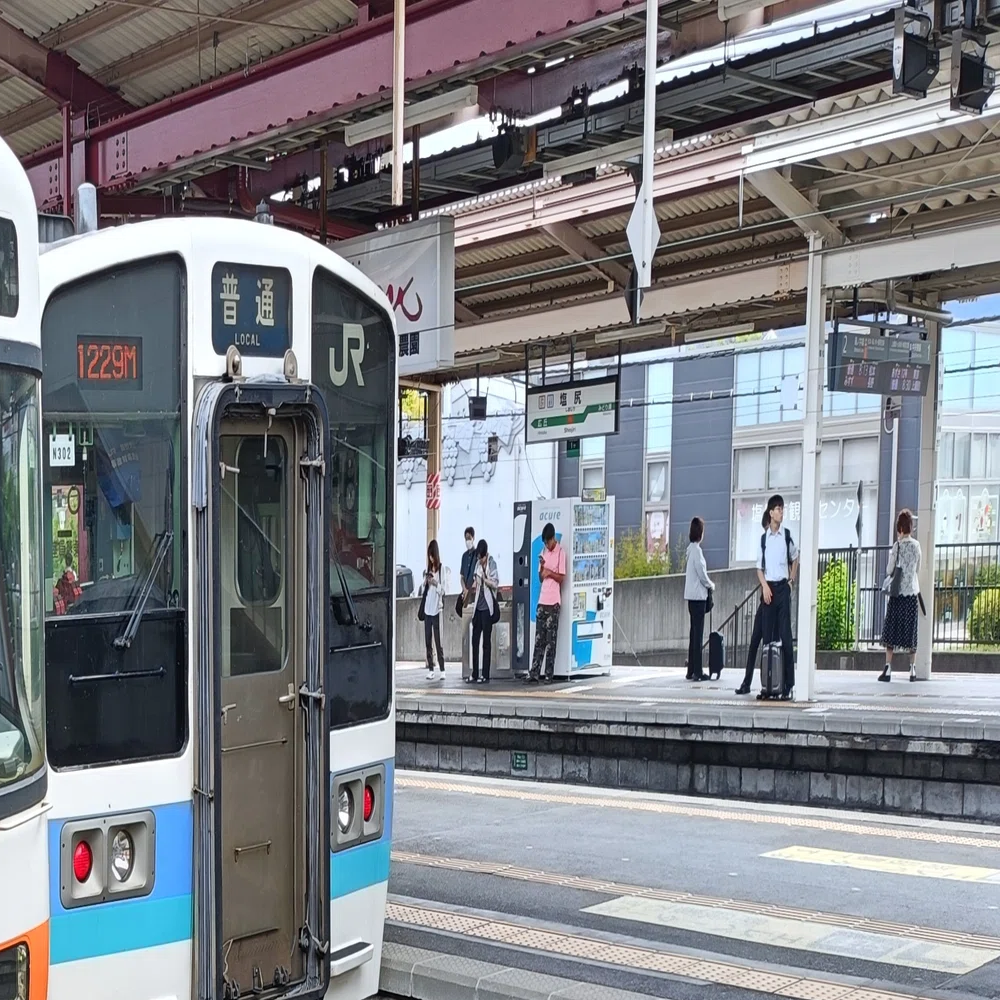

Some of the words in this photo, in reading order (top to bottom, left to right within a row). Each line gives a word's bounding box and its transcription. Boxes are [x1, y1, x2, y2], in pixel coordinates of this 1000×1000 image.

[220, 273, 275, 326] 普通
[234, 333, 261, 346] LOCAL
[843, 335, 848, 353] 2
[78, 344, 137, 379] 1229M
[329, 323, 365, 387] JR
[560, 390, 582, 407] 塩尻
[52, 446, 71, 460] N302
[539, 511, 561, 521] acure
